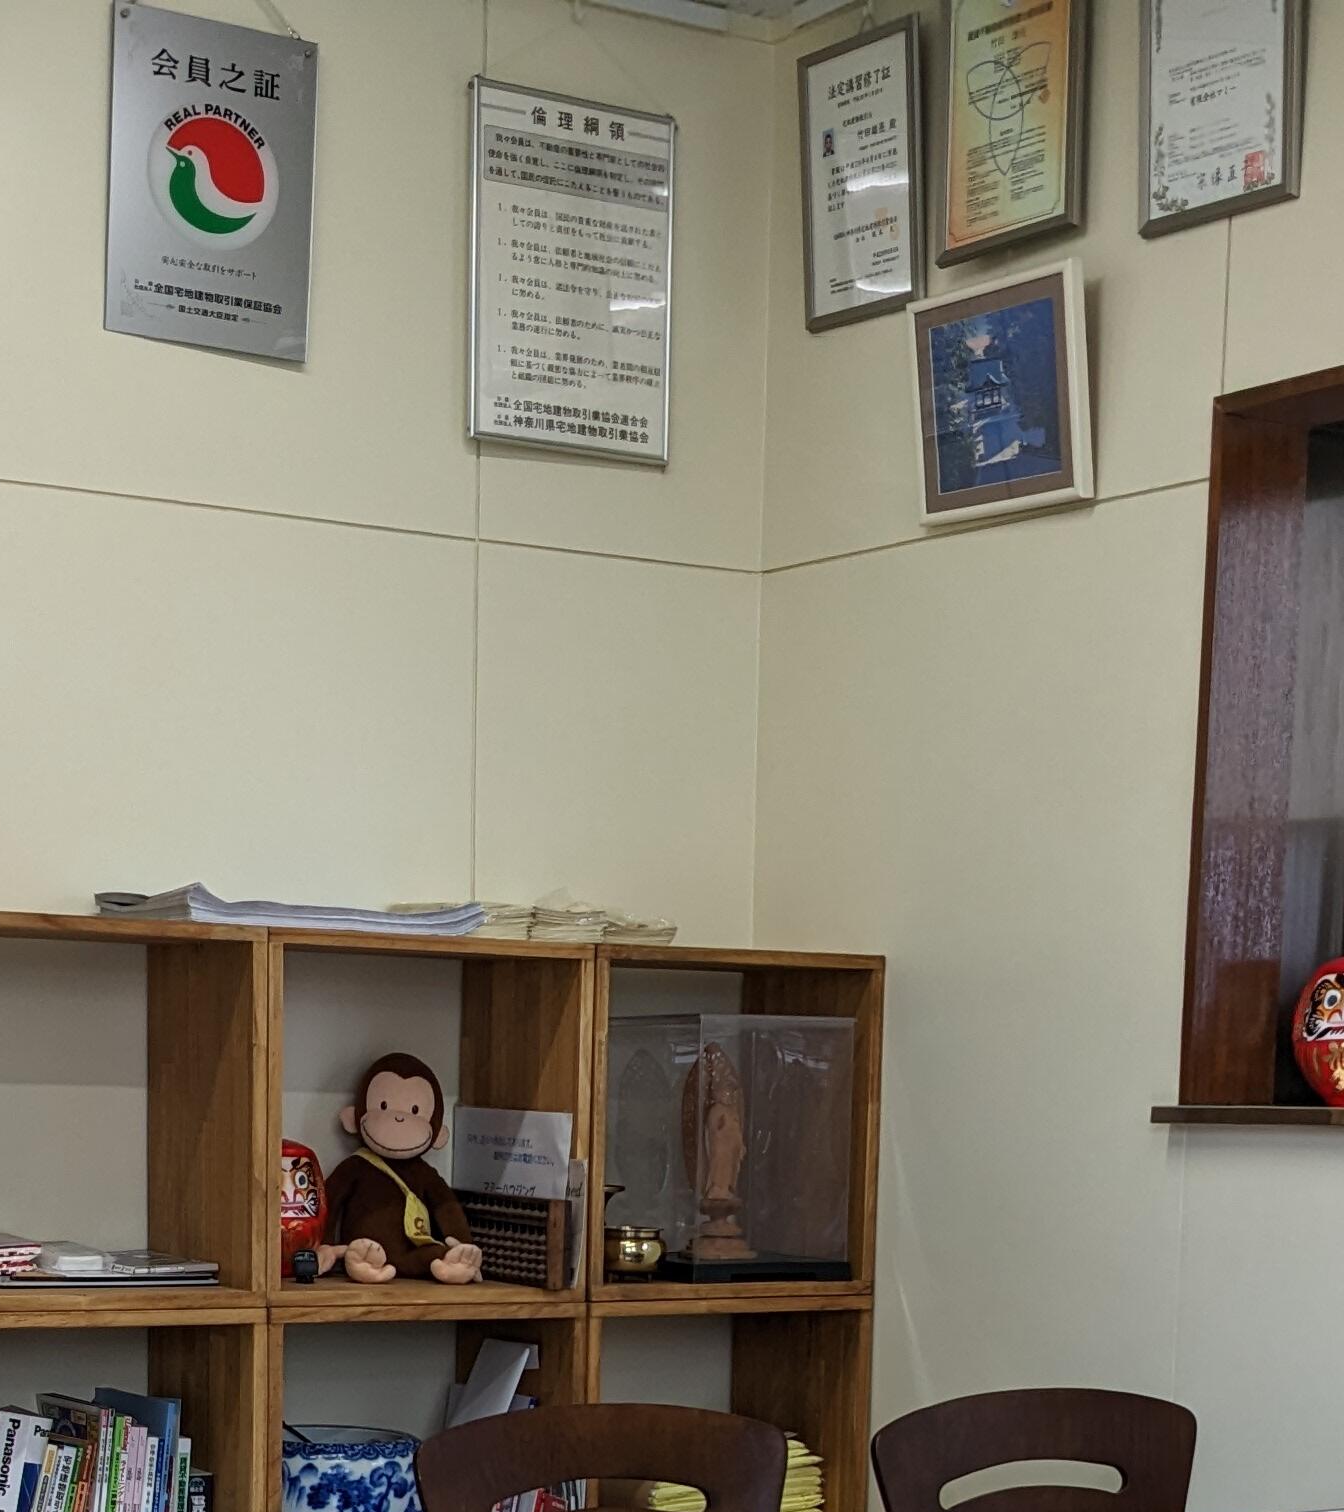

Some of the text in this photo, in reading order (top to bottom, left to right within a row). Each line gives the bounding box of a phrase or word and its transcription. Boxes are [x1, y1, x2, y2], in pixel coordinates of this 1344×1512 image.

[151, 47, 281, 102] 会員之証
[163, 103, 266, 150] REAL PARTNER
[530, 106, 626, 142] 倫理綱領
[154, 282, 283, 315] 全国宅地建物取引業保証協会
[178, 304, 239, 322] 国土交通大臣指定
[513, 399, 648, 429] 全国宅地建物取引業協会連合会
[513, 414, 649, 444] 神奈川県宅地建物取引業協会
